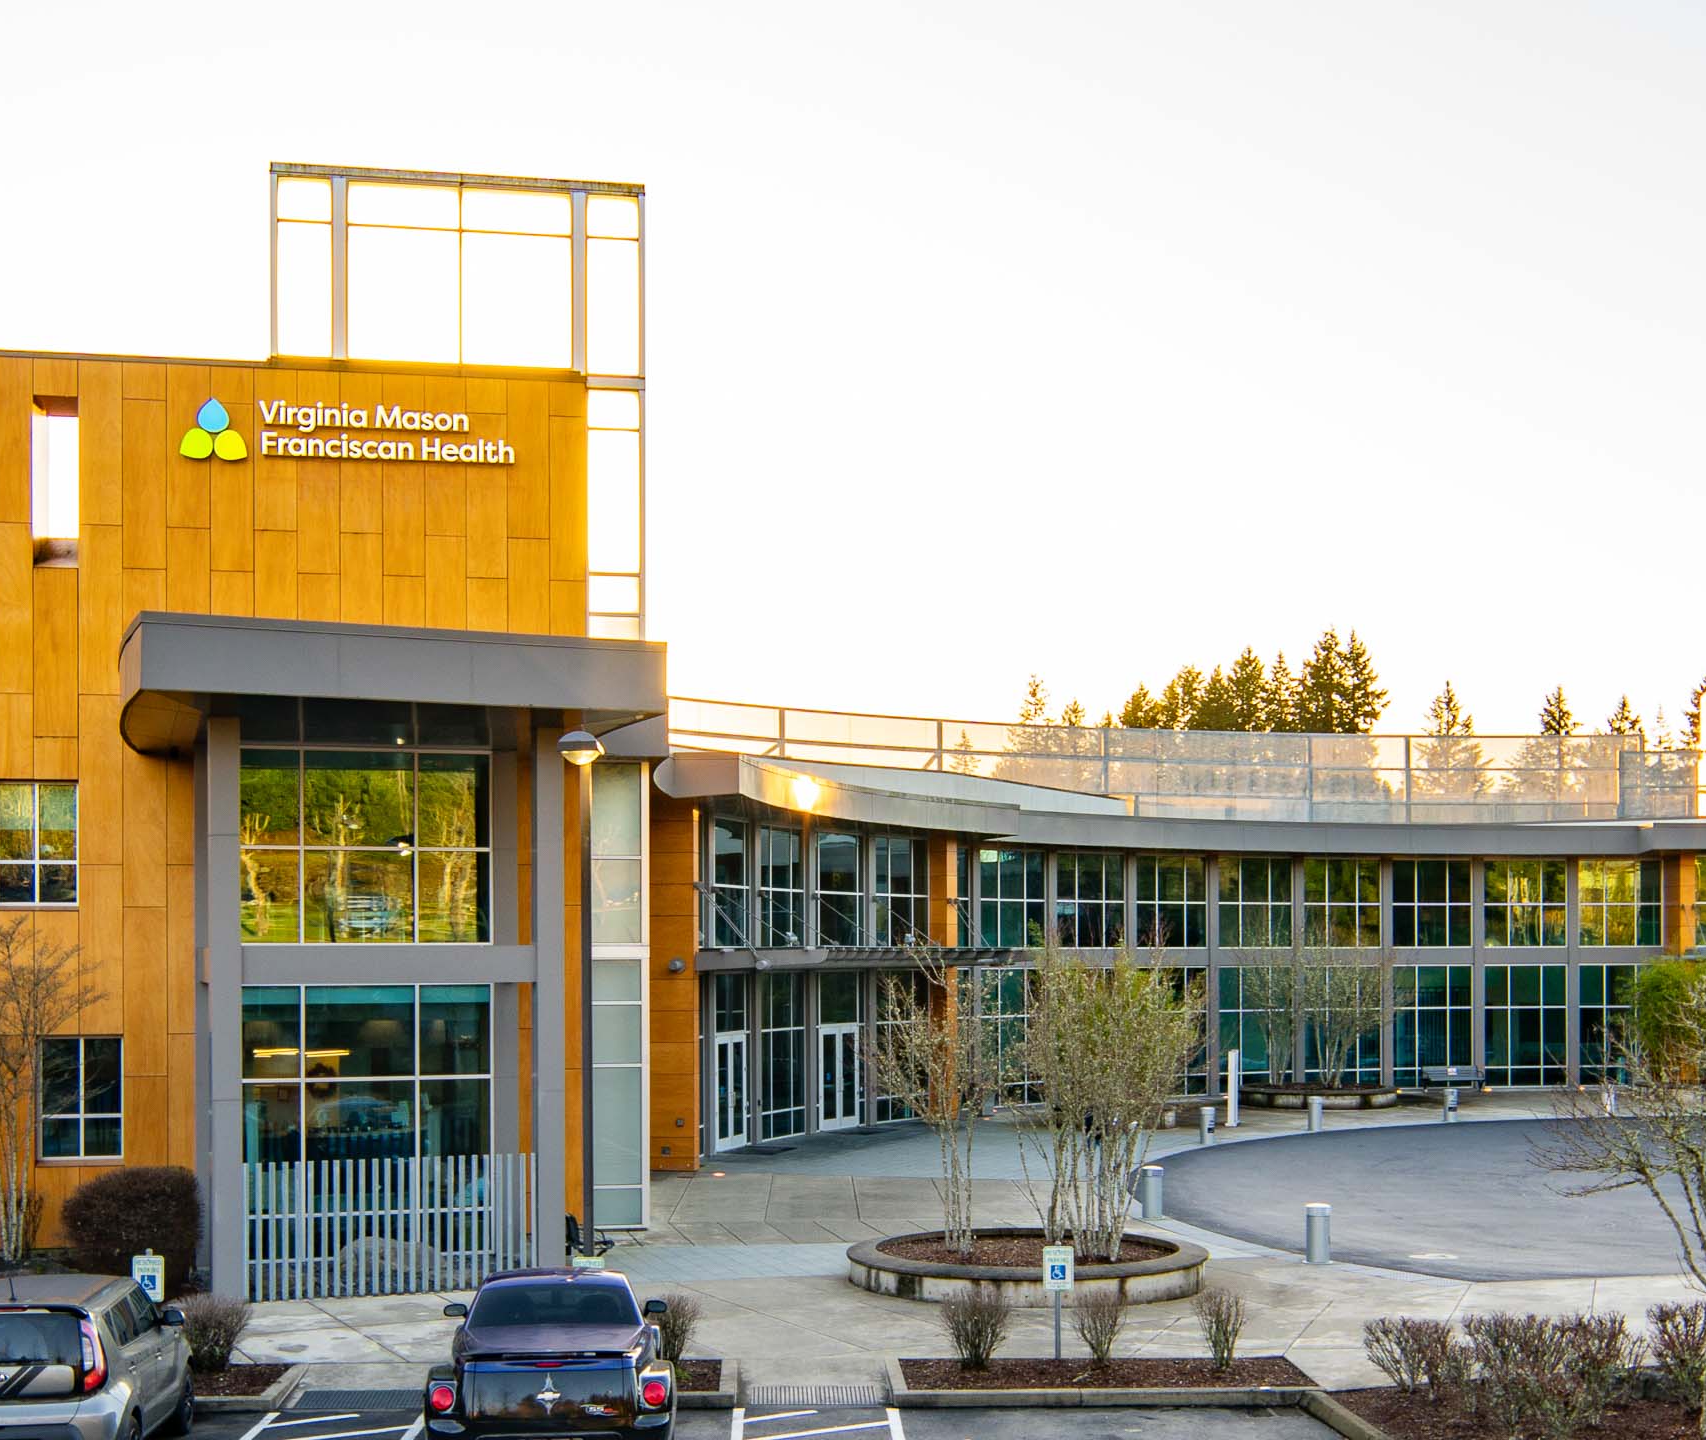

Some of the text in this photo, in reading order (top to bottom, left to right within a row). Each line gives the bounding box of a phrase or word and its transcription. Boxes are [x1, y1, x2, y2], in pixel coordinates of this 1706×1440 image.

[259, 400, 470, 432] Virginia Mason
[260, 431, 516, 464] Franciscan Health
